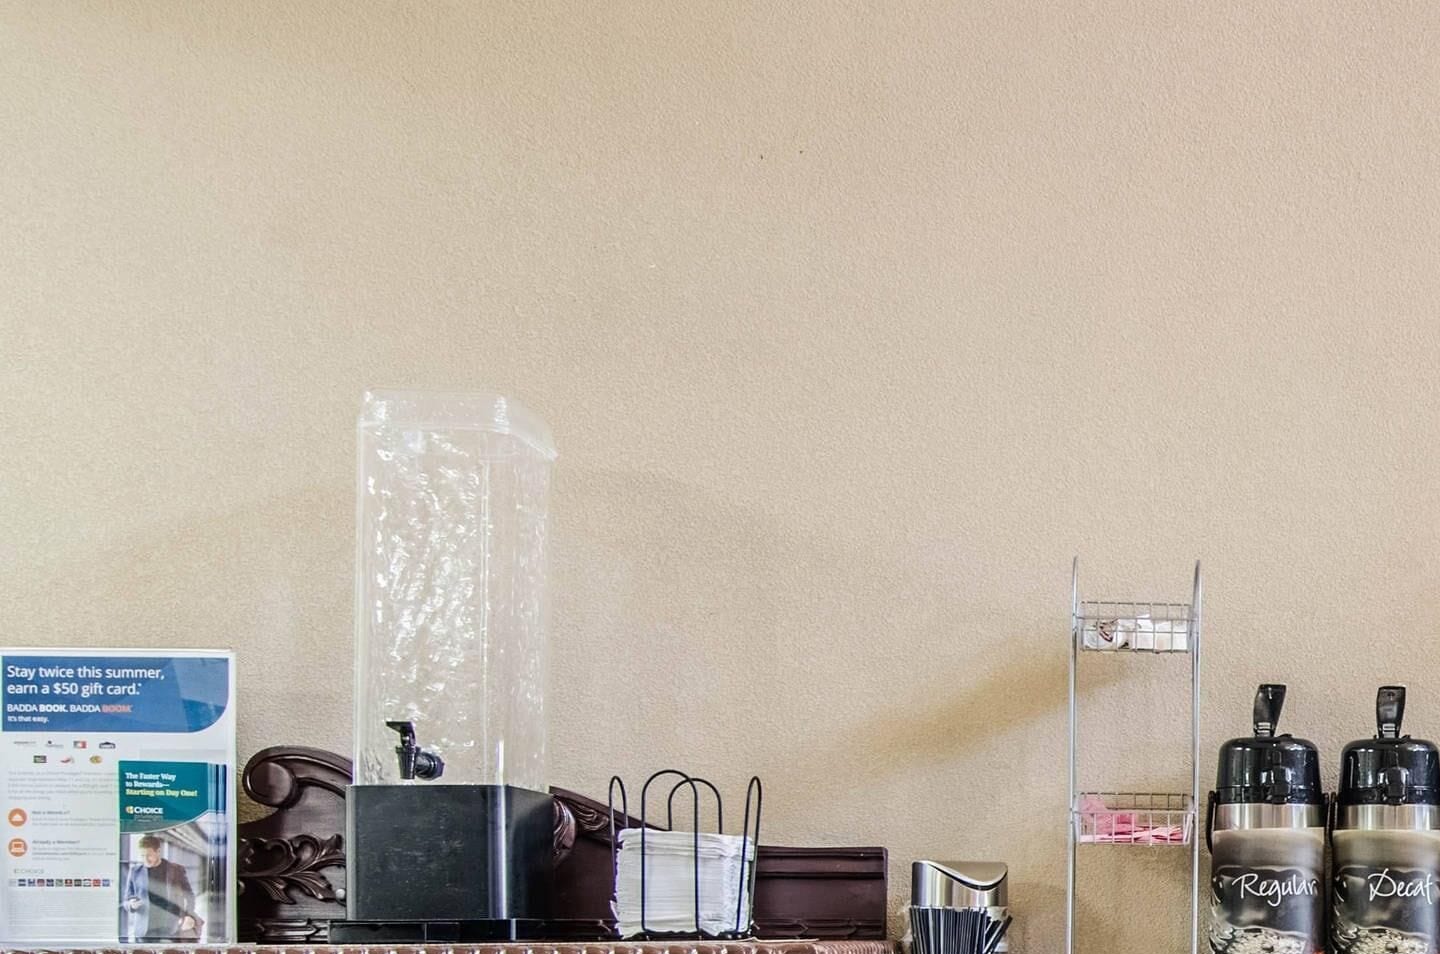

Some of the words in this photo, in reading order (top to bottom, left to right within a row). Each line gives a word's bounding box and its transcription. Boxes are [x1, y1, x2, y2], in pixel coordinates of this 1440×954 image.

[7, 665, 35, 681] Stay
[39, 666, 74, 678] twice
[77, 666, 103, 678] this
[105, 668, 165, 680] summer,
[7, 684, 38, 695] earn
[41, 684, 50, 695] a
[53, 682, 78, 695] $50
[81, 682, 103, 698] gift
[7, 703, 38, 713] BADDA
[70, 704, 101, 713] BADDA
[134, 806, 164, 814] CHOICE
[1232, 872, 1319, 907] Regular
[1367, 868, 1433, 905] Decaf
